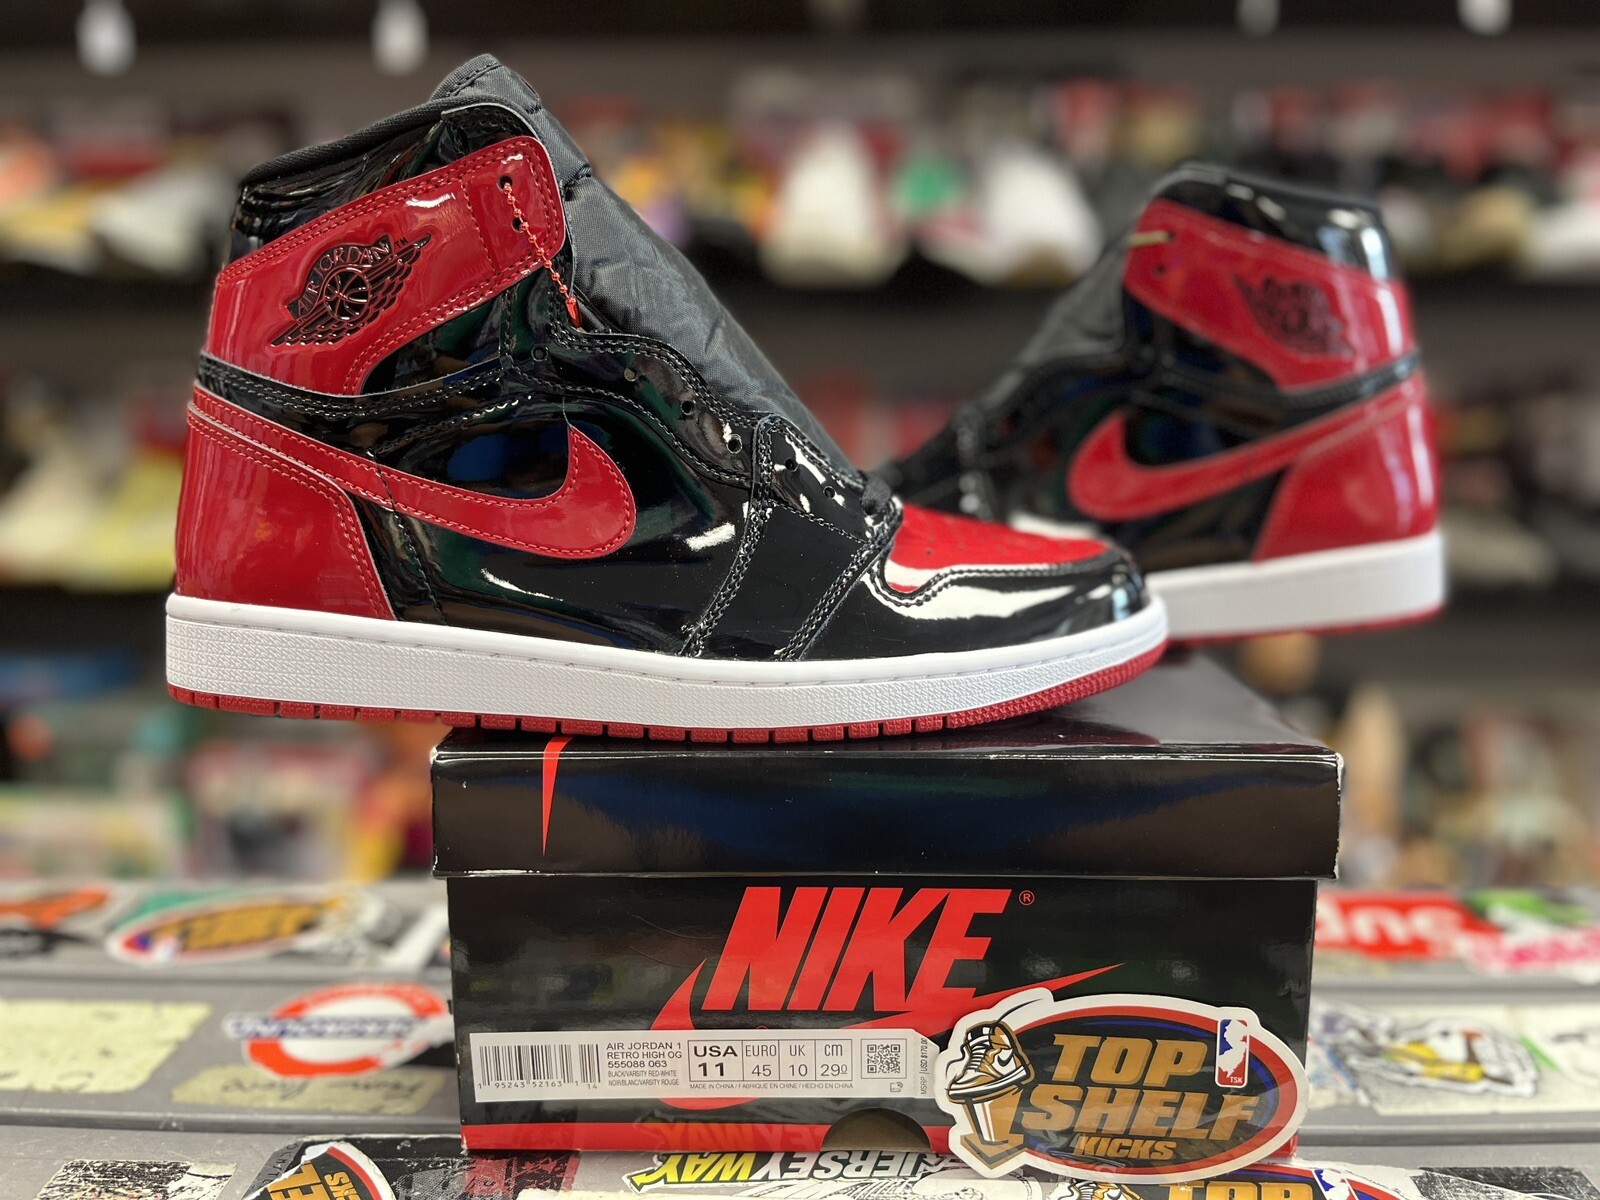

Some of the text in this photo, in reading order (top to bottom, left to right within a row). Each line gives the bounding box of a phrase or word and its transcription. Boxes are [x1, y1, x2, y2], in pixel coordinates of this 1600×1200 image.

[297, 243, 391, 313] AIR JORDAN
[701, 886, 1013, 1012] NIKE
[606, 1042, 625, 1050] AIR
[627, 1042, 673, 1050] JORDAN
[606, 1051, 682, 1060] RETRO HIGH OG
[693, 1045, 738, 1057] USA
[745, 1044, 777, 1057] EURO
[789, 1044, 806, 1057] UK
[920, 1038, 928, 1058] $170.00
[607, 1060, 667, 1068] 555088 063
[698, 1062, 725, 1077] 11
[751, 1064, 772, 1077] 45
[789, 1064, 808, 1077] 10
[1053, 1033, 1208, 1088] TOP
[1021, 1084, 1260, 1141] SHELF
[1072, 1134, 1179, 1160] KICKS
